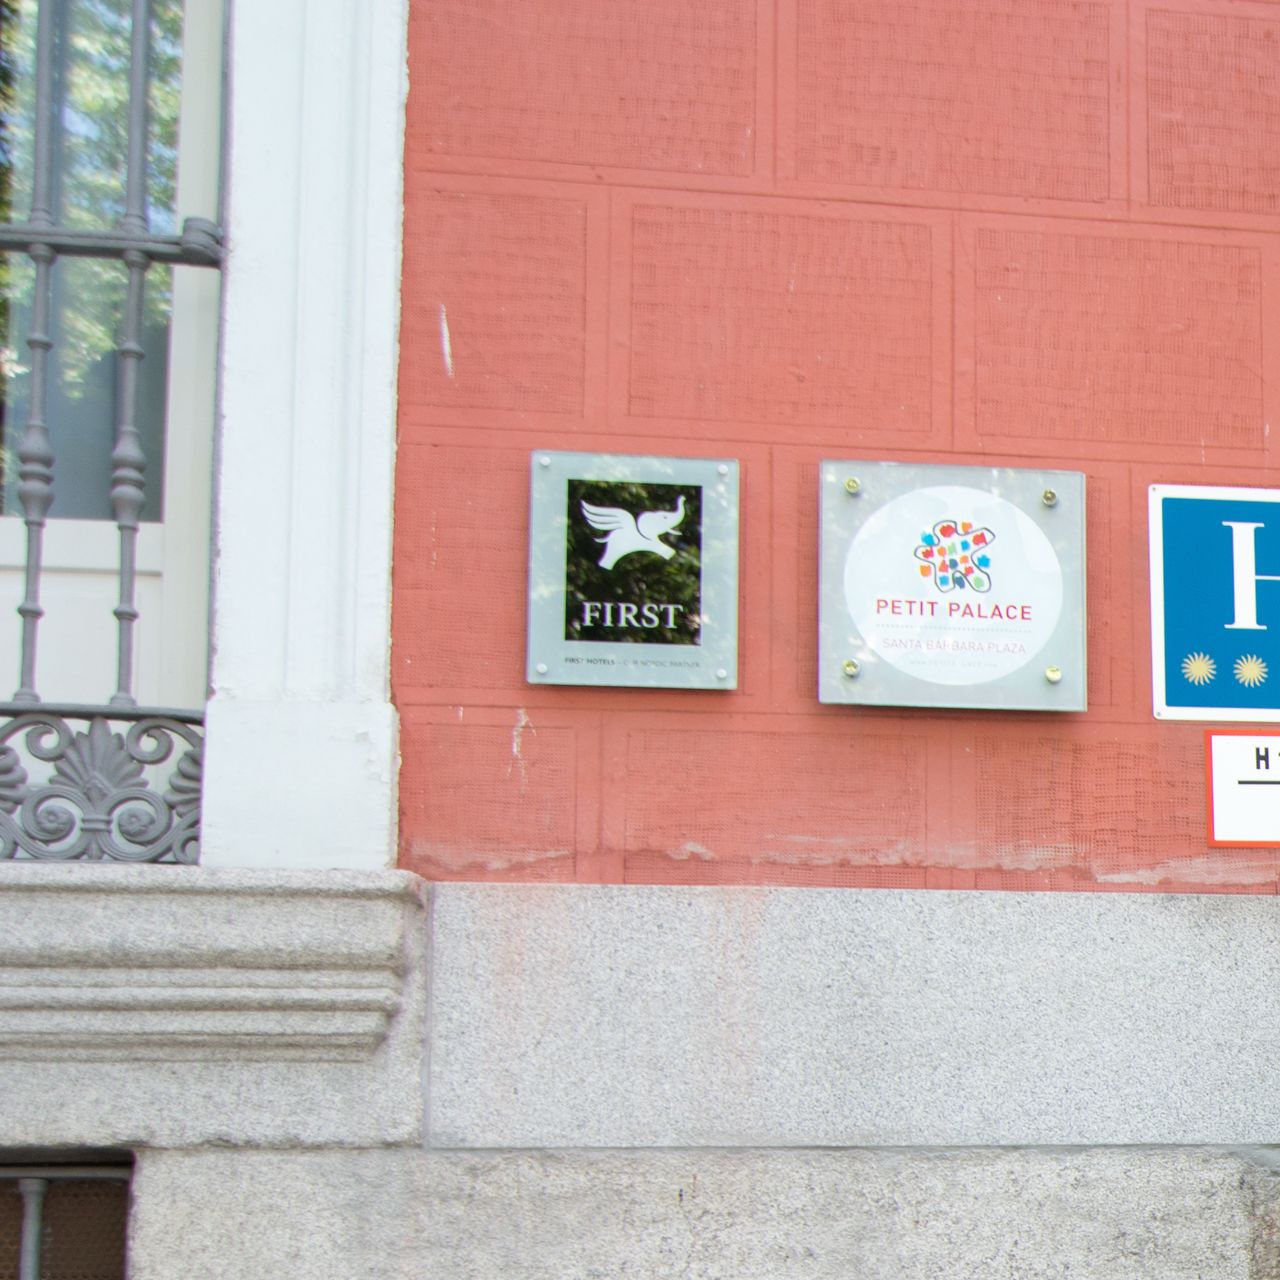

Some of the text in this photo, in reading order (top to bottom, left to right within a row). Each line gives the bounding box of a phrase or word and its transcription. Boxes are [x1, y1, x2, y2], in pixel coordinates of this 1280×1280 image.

[581, 600, 685, 629] FIRST
[875, 598, 1033, 621] PETIT PALACE
[881, 638, 923, 650] SANTA
[987, 640, 1027, 655] PLAZA
[586, 657, 616, 666] HOTELS
[1255, 746, 1270, 770] H
